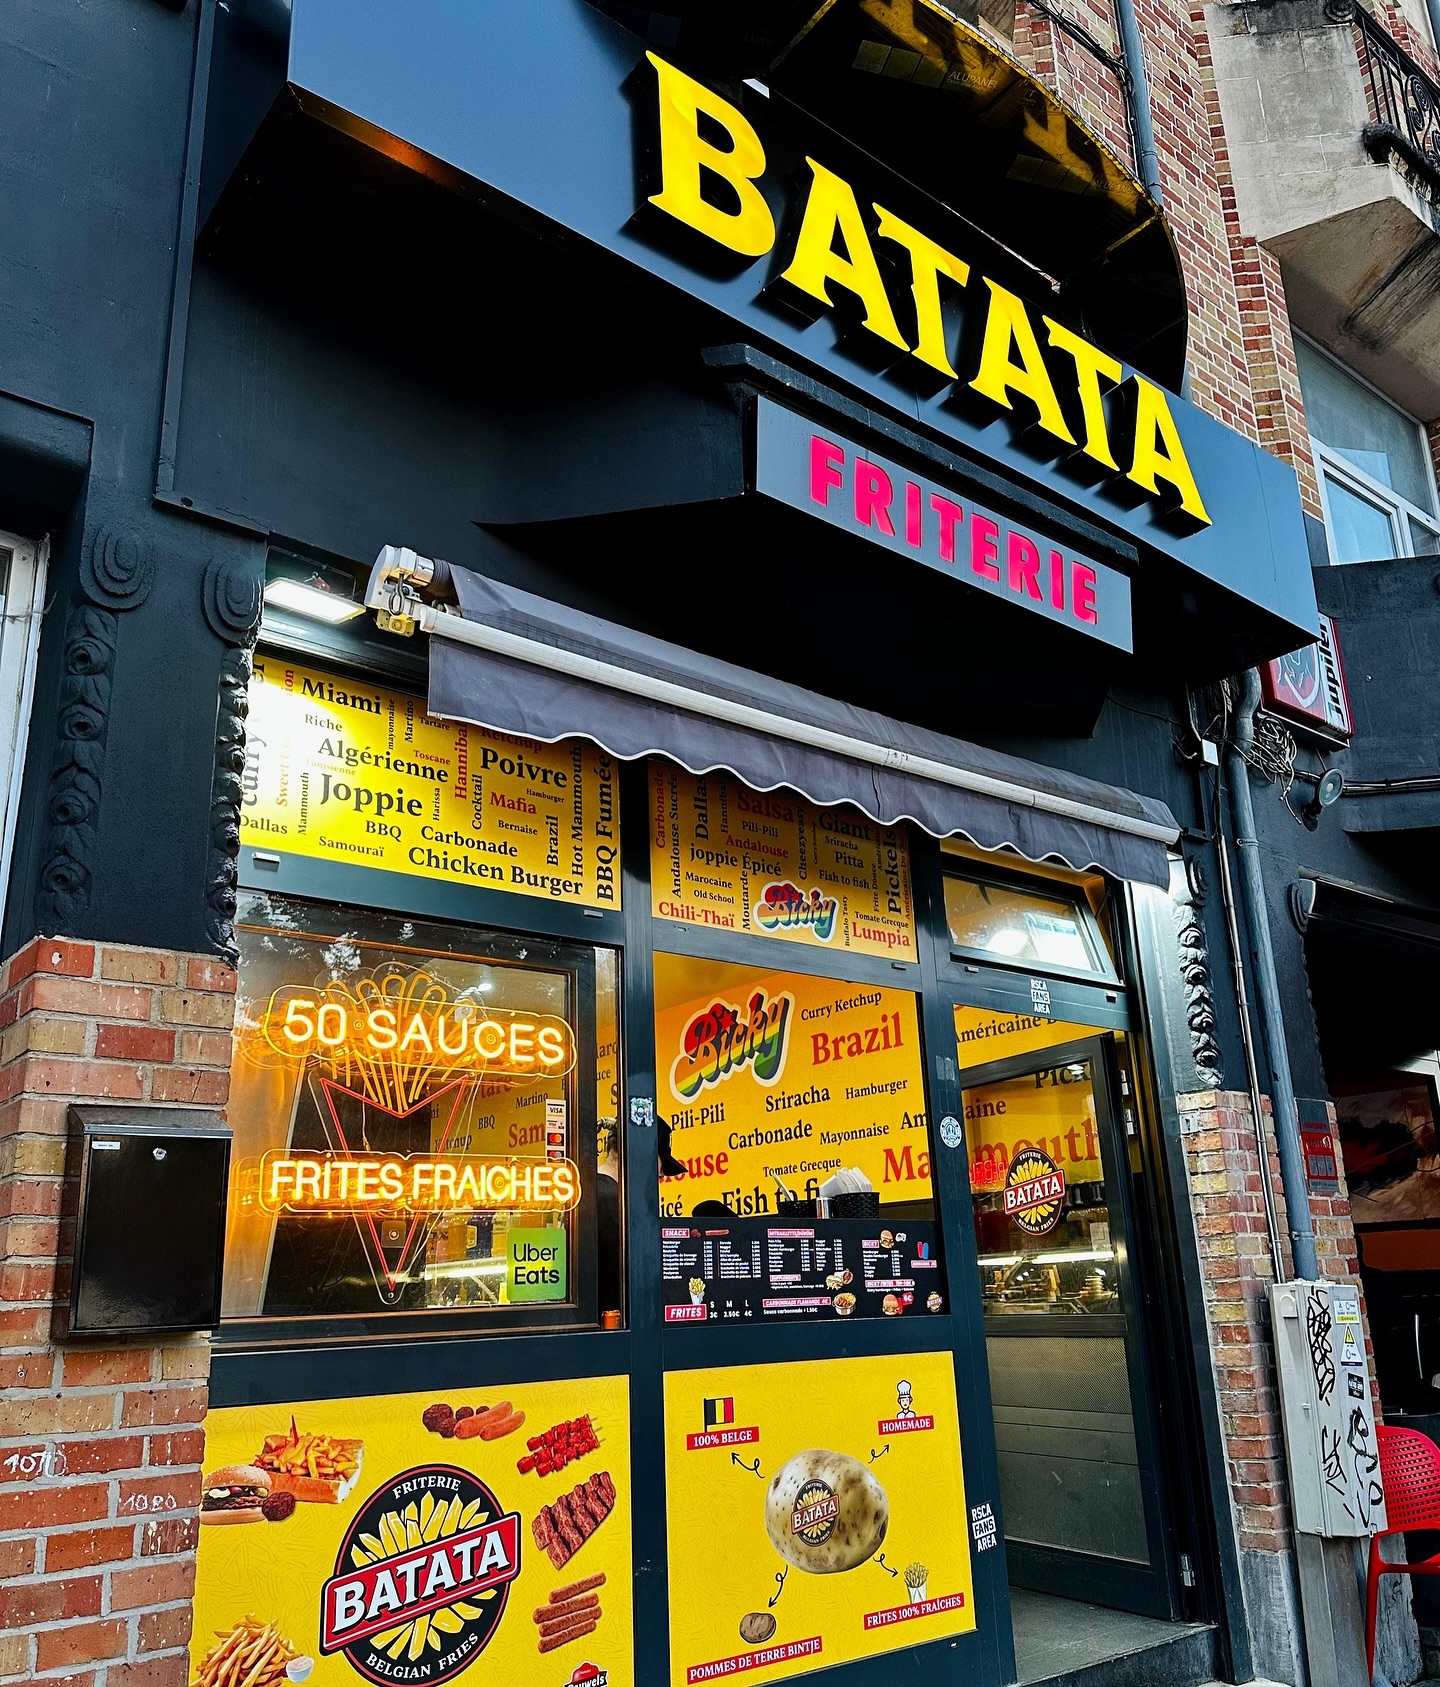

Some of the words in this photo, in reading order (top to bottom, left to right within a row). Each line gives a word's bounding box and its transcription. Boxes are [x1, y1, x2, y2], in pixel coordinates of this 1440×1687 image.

[646, 50, 1213, 526] BATATA
[810, 434, 1098, 625] FRITERIE
[301, 676, 382, 716] Miami
[304, 712, 344, 733] Riche
[388, 699, 396, 750] mayonnaise
[405, 701, 414, 743] Martino
[419, 716, 450, 731] Tartare
[318, 736, 450, 784] Algérienne
[413, 750, 451, 766] Toscane
[480, 747, 567, 788] Poivre
[298, 771, 310, 836] Mammouth
[320, 772, 423, 817] Joppie
[432, 787, 441, 821] Harissa
[472, 774, 483, 830] Cocktail
[490, 791, 537, 815] Mafia
[526, 788, 565, 803] Hamburger
[569, 746, 583, 842] Mammouth
[593, 754, 614, 840] Fumée
[668, 774, 679, 820] Sucrée
[693, 776, 709, 841] Dallas
[737, 791, 795, 823] Salsa
[654, 770, 666, 848] Carbonade
[240, 815, 288, 834] Dallas
[365, 820, 402, 842] BBQ
[498, 820, 539, 836] Bernaise
[742, 820, 779, 838] Pili-Pili
[818, 812, 871, 841] Giant
[318, 836, 384, 858] Samouraï
[421, 825, 518, 857] Carbonade
[545, 814, 559, 867] Brazil
[725, 834, 789, 859] Andalouse
[825, 835, 859, 851] Sriracha
[408, 846, 505, 881] Chicken
[510, 865, 584, 897] Burger
[571, 845, 583, 877] Hot
[671, 823, 682, 898] Andalouse
[690, 843, 738, 870] joppie
[742, 852, 782, 877] Épicé
[835, 850, 864, 869] Pitta
[883, 830, 902, 915] Pickels
[596, 847, 618, 902] BBQ
[685, 871, 733, 889] Marocaine
[818, 869, 838, 883] Fish
[841, 873, 851, 885] to
[852, 876, 871, 890] fish
[693, 889, 707, 900] Old
[708, 892, 735, 904] School
[739, 870, 751, 930] Moutarde
[756, 883, 837, 939] Bicky
[658, 901, 735, 928] Chili-Thaï
[855, 911, 881, 924] Tomate
[881, 916, 909, 930] Grecque
[852, 922, 911, 949] Lumpia
[1030, 979, 1048, 991] RSCA
[1032, 991, 1049, 1002] FANS
[801, 1003, 833, 1021] Curry
[835, 991, 882, 1014] Ketchup
[1034, 1002, 1051, 1014] AREA
[283, 1000, 346, 1046] 50
[367, 1009, 564, 1064] SAUCES
[674, 991, 790, 1099] Bicky
[810, 1011, 904, 1066] Brazil
[515, 1092, 549, 1110] Martino
[765, 1085, 831, 1113] Sriracha
[845, 1077, 908, 1100] Hamburger
[478, 1115, 496, 1130] BBQ
[671, 1102, 726, 1131] Pili-Pili
[728, 1119, 813, 1151] Carbonade
[819, 1123, 890, 1147] Mayonnaise
[271, 1160, 404, 1200] FRITES
[412, 1164, 575, 1202] FRAICHES
[763, 1162, 798, 1178] Tomate
[799, 1158, 842, 1175] Grecque
[1005, 1175, 1062, 1210] BATATA
[513, 1243, 558, 1263] Uber
[514, 1266, 560, 1285] Eats
[670, 1307, 702, 1318] FRITES
[693, 1434, 719, 1447] 100%
[721, 1430, 753, 1444] BELGE
[882, 1418, 931, 1433] HOMEMADE
[392, 1475, 461, 1500] FRITERIE
[794, 1499, 836, 1529] BATATA
[971, 1503, 992, 1522] RSCA
[974, 1518, 994, 1537] FANS
[978, 1533, 997, 1552] AREA
[331, 1528, 511, 1633] BATATA
[898, 1606, 920, 1619] 100%
[365, 1651, 432, 1679] BELGIAN
[438, 1632, 479, 1670] FRIES
[690, 1659, 736, 1681] POMMES
[738, 1656, 752, 1669] DE
[754, 1648, 786, 1665] TERRE
[787, 1638, 820, 1659] BINTJE
